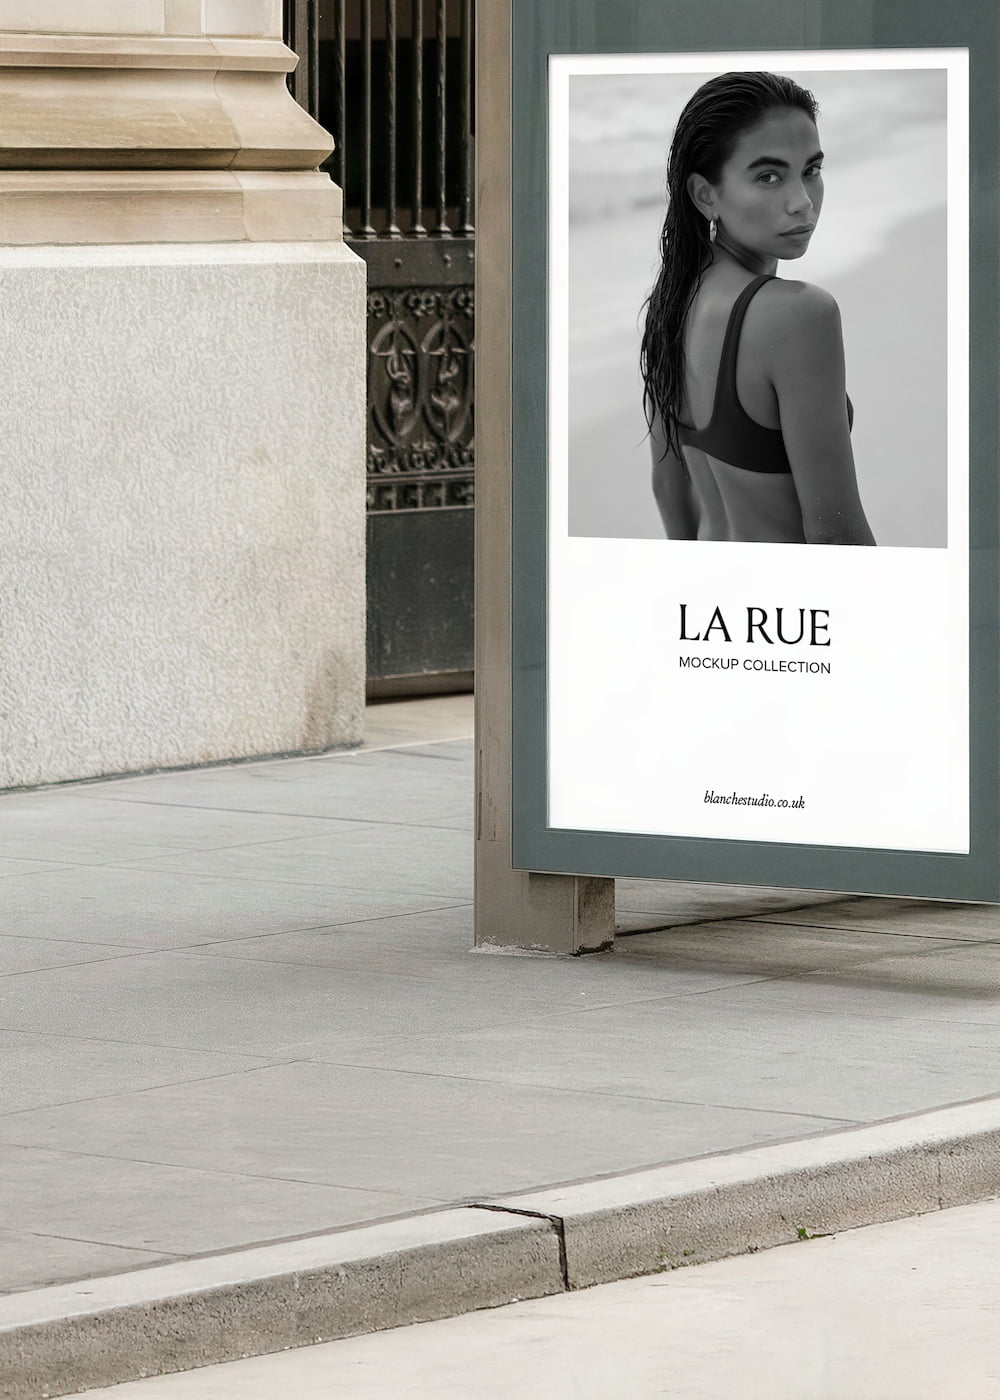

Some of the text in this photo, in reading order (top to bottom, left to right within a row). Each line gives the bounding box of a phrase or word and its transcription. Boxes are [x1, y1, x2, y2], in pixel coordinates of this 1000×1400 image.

[679, 603, 831, 647] LA RUE
[679, 656, 831, 674] MOCKUP COLLECTION
[703, 790, 806, 809] blanchestudio.co.uk
